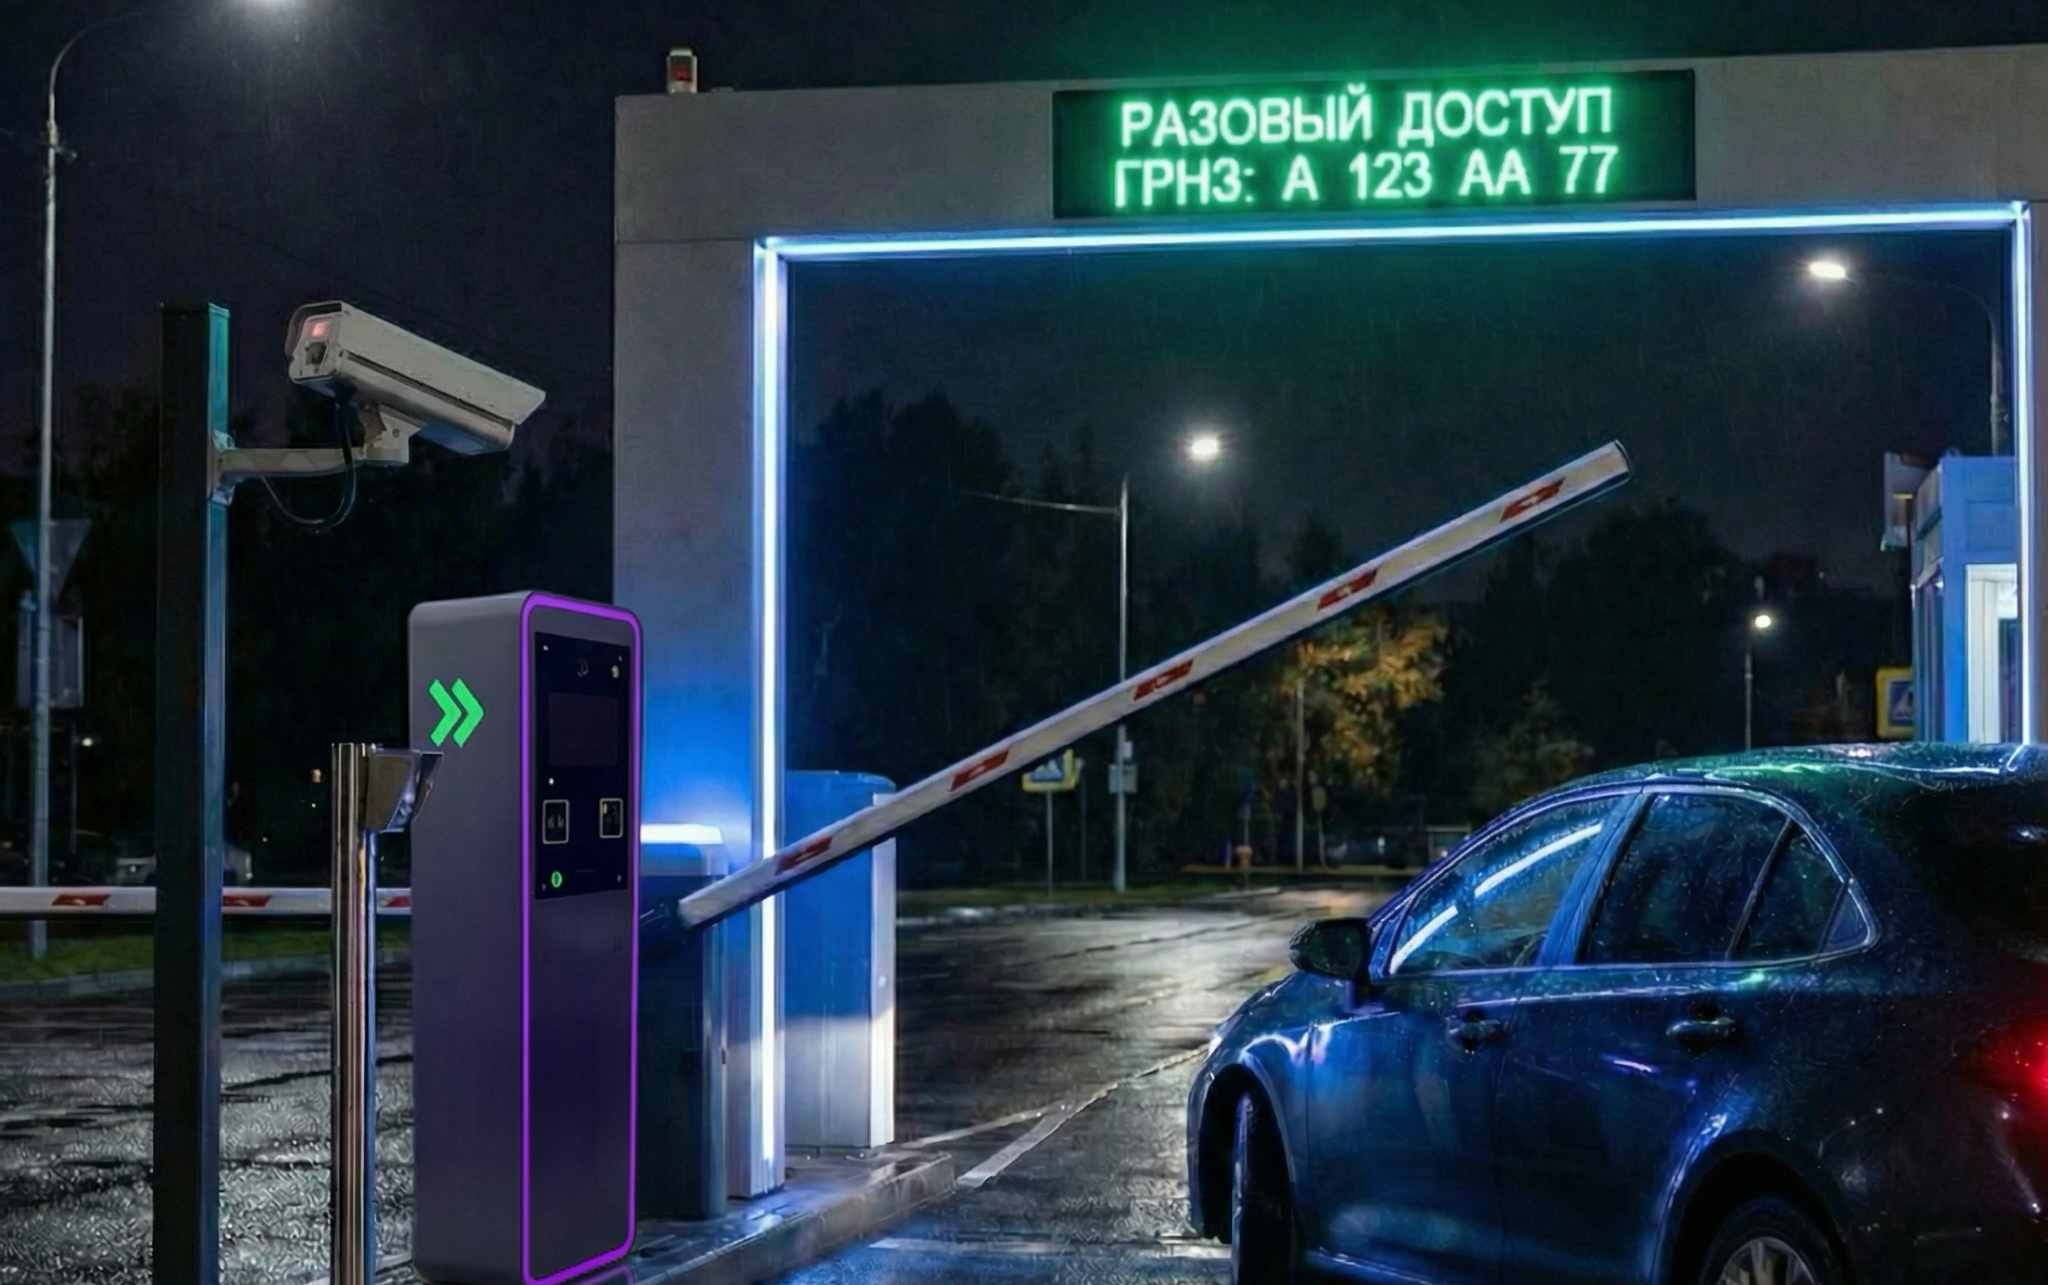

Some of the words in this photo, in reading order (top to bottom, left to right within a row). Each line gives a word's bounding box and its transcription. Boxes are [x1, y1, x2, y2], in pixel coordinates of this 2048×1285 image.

[1121, 83, 1372, 147] РАЗОВЫЙ
[1397, 86, 1613, 149] ДОСТУП
[1114, 157, 1254, 208] ГРНЗ:
[1282, 154, 1319, 201] А
[1348, 151, 1433, 200] 123
[1458, 148, 1531, 196] АА
[1558, 144, 1618, 194] 77
